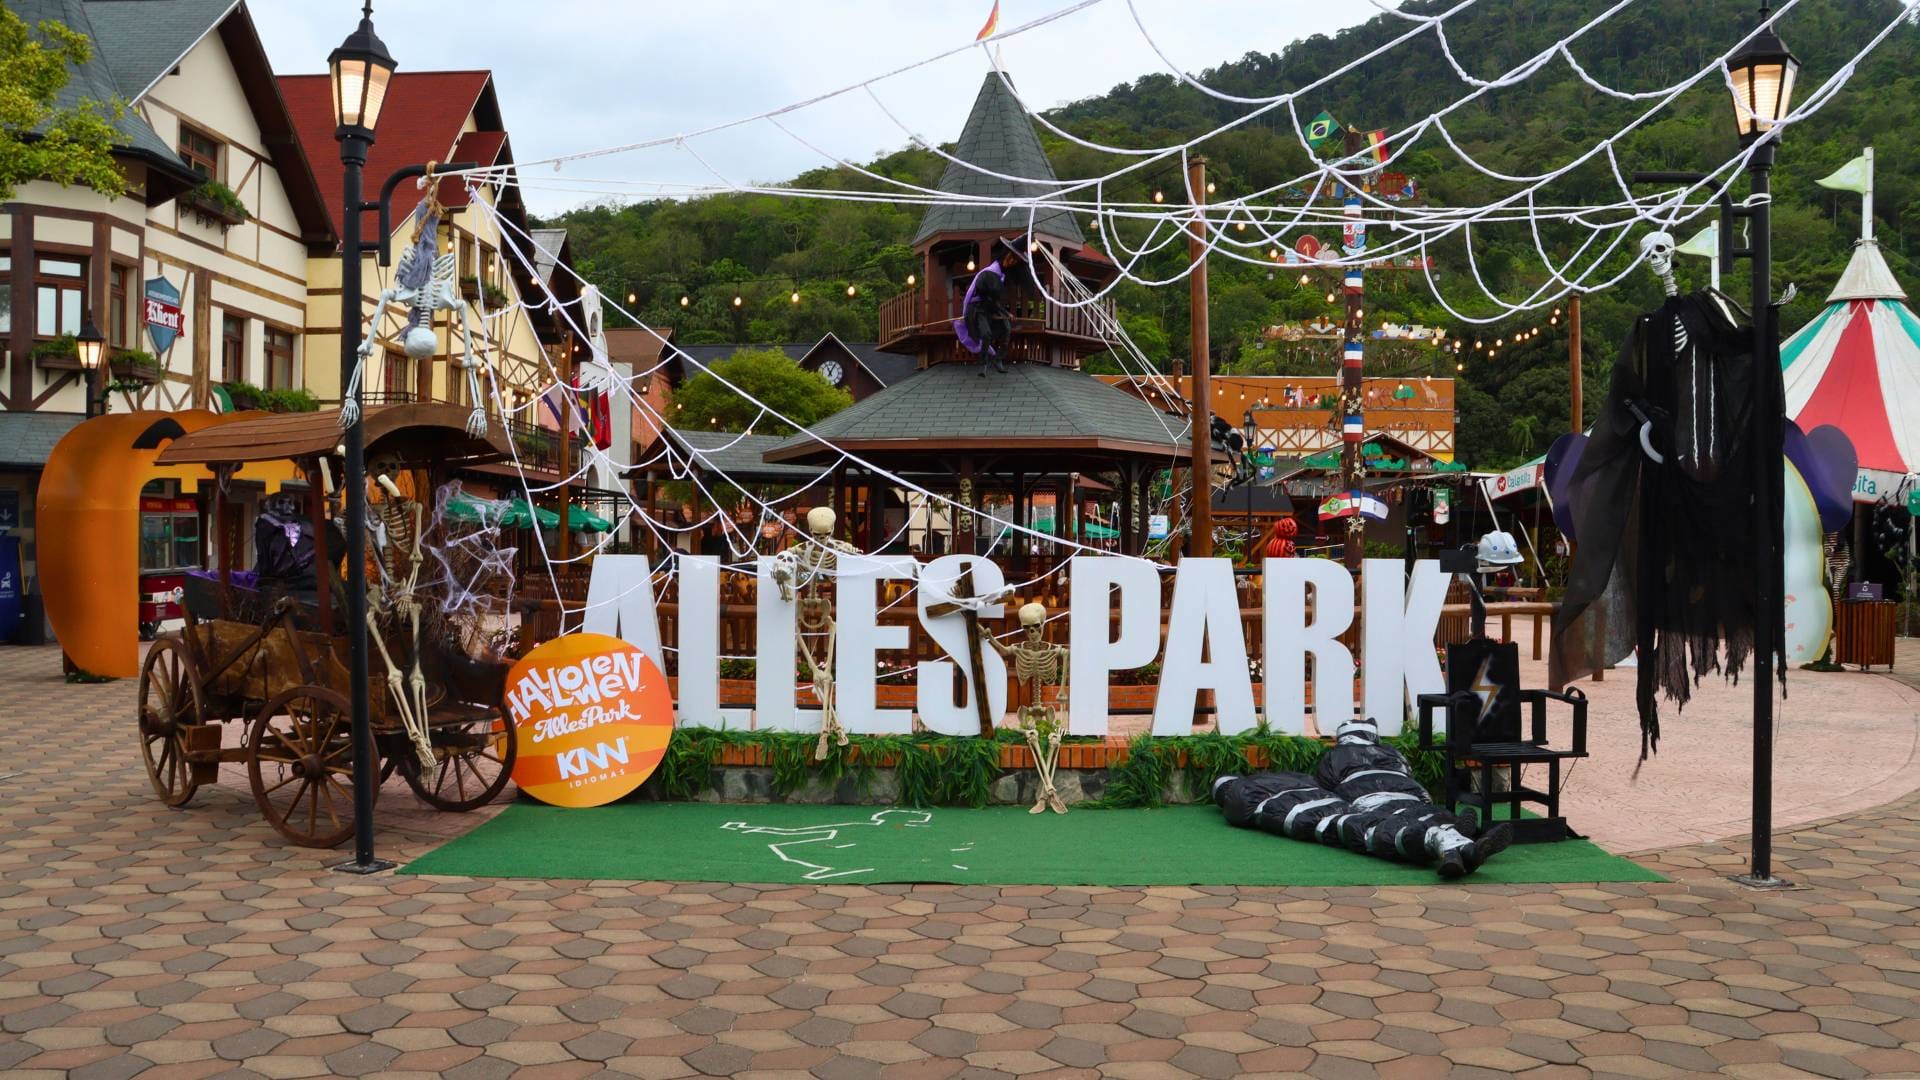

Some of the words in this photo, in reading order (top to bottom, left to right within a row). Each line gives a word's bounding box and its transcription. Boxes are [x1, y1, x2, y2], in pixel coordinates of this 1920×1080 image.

[581, 554, 1007, 736] ALLES
[1069, 557, 1452, 736] PARK
[557, 737, 629, 780] KNN
[569, 768, 625, 789] IDIOMAS
